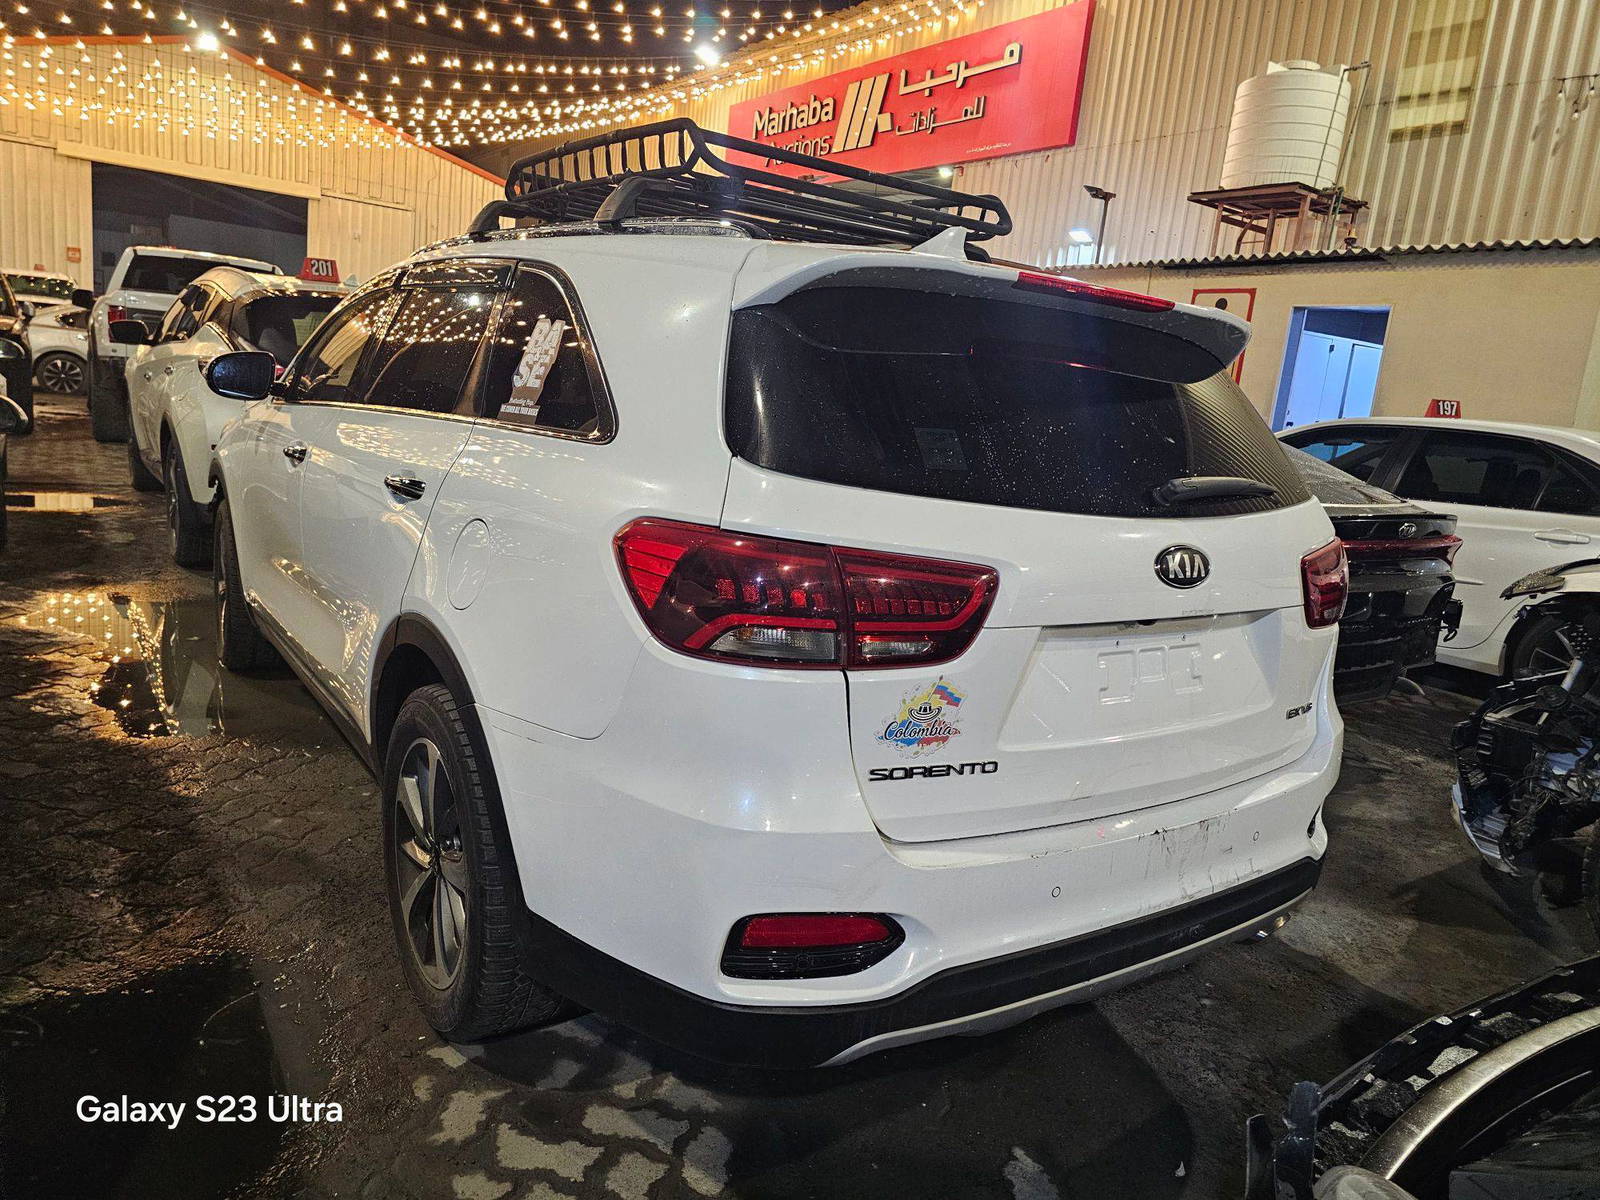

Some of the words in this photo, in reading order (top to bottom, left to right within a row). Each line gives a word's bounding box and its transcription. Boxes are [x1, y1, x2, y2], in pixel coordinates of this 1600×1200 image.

[899, 42, 1022, 97] مرحبا
[752, 94, 836, 140] Marhaba
[896, 95, 987, 135] للمزادات
[310, 259, 333, 277] 201
[1438, 400, 1458, 416] 197
[1165, 551, 1206, 579] KIA
[884, 720, 953, 741] Colombia
[868, 760, 999, 782] SORENTO
